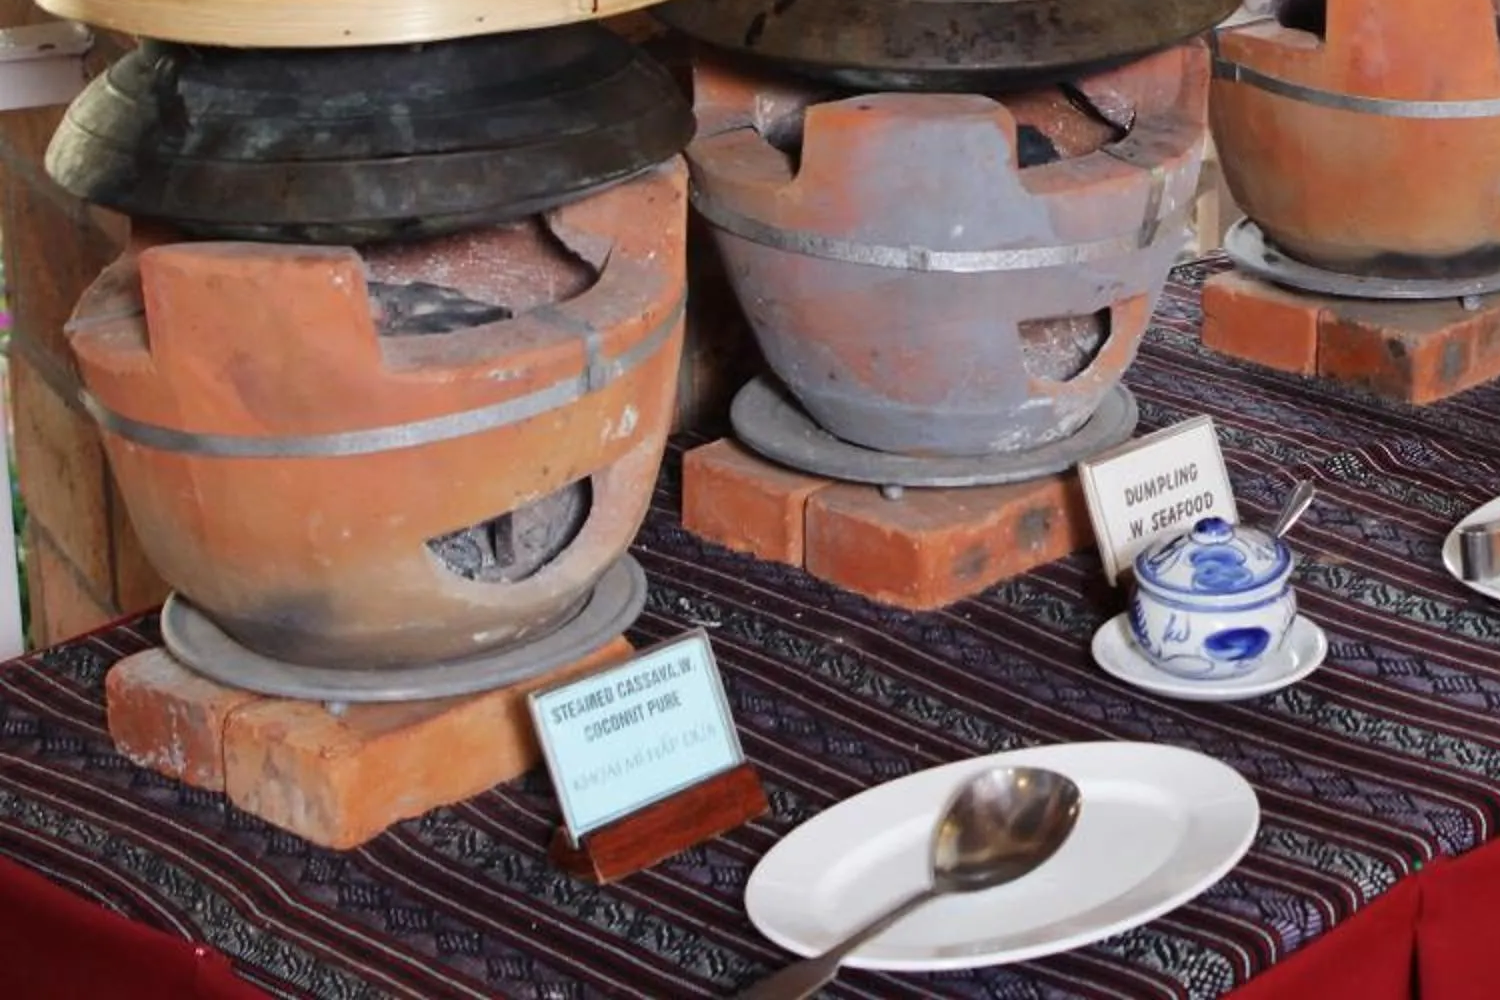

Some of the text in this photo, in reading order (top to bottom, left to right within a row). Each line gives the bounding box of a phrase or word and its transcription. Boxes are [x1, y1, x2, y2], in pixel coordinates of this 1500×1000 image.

[1124, 463, 1199, 507] DUMPLING
[1151, 491, 1214, 532] SEAFOOD
[550, 687, 614, 725] STEAMED
[583, 690, 683, 743] COCONUT PURE
